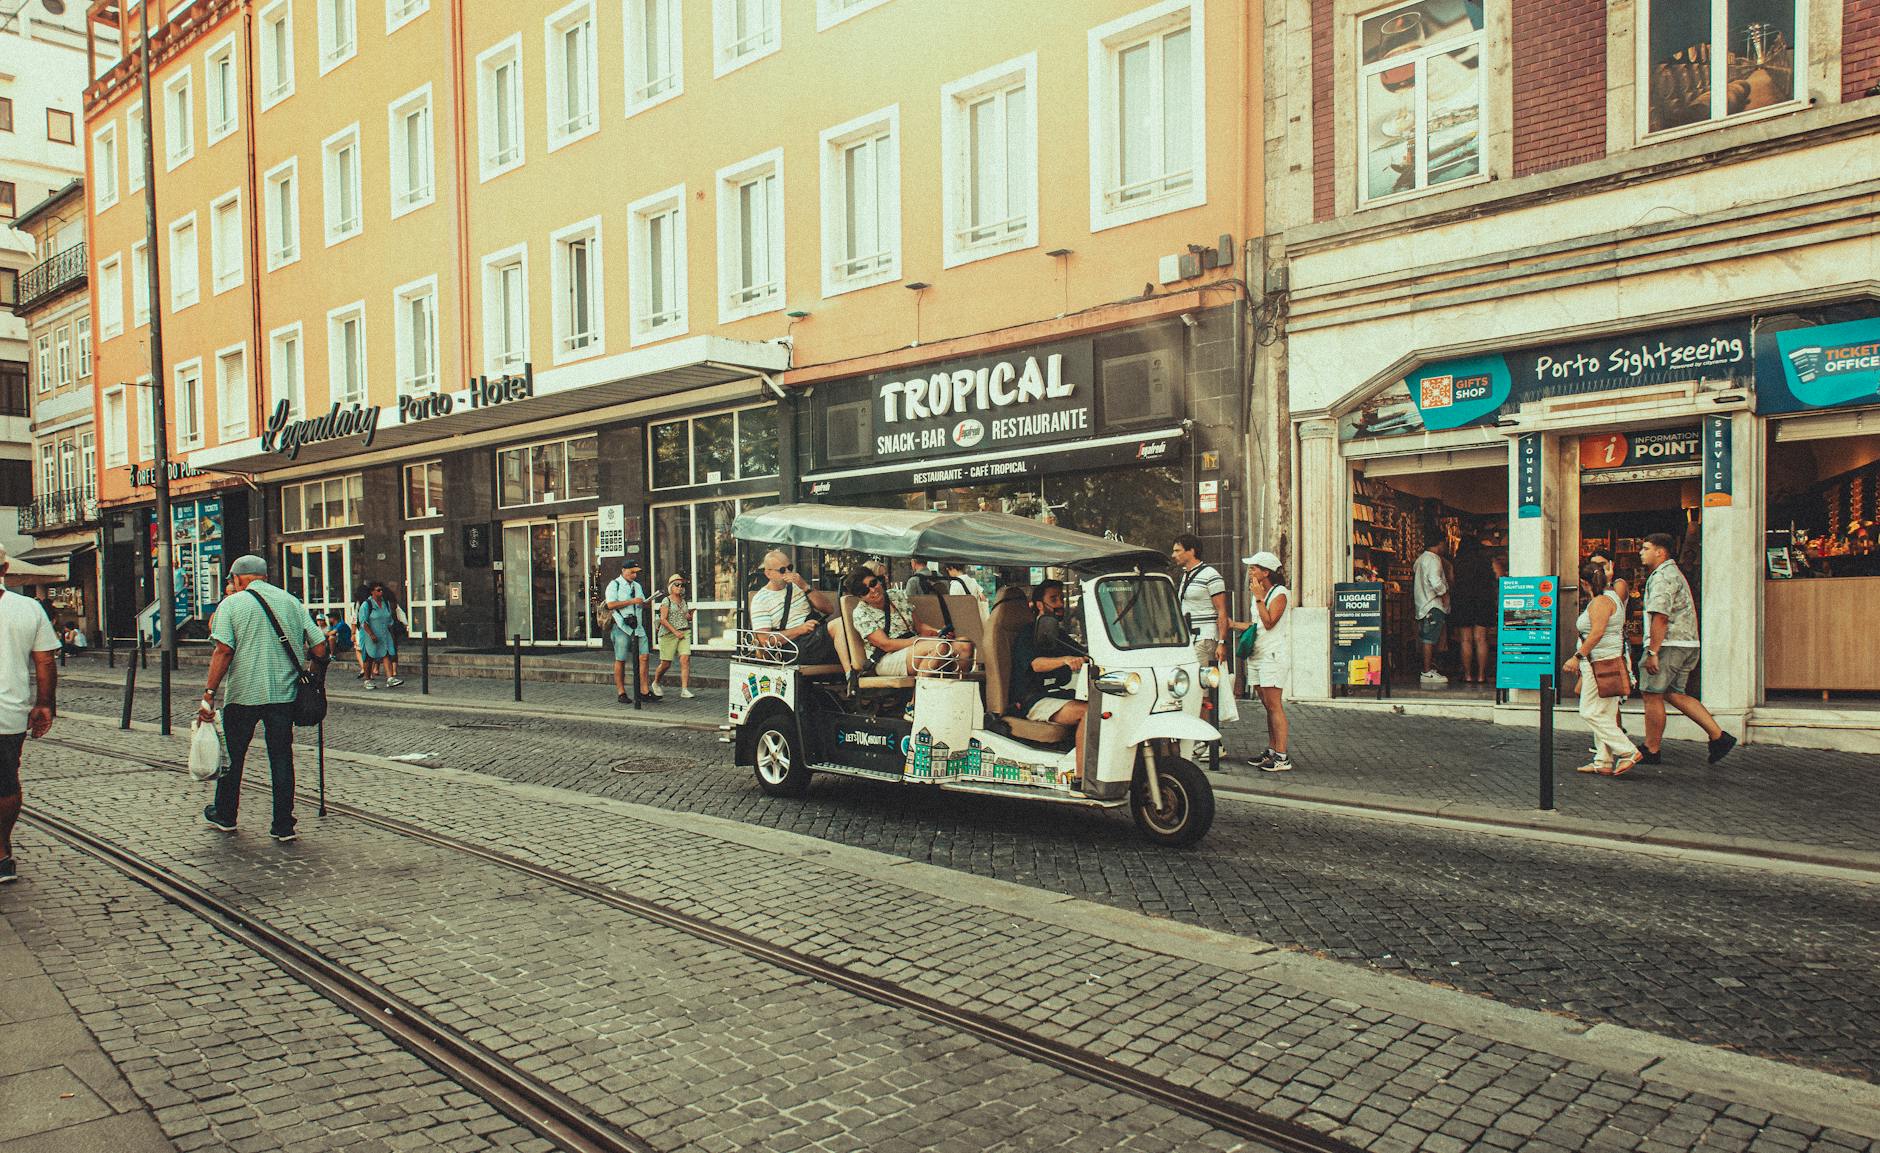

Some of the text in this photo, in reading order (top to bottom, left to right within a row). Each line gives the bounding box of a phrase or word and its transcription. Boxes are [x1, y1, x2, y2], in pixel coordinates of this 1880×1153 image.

[1535, 337, 1744, 380] Porto Sightseeing
[1825, 355, 1880, 372] OFFICE
[880, 353, 1075, 423] TROPICAL
[1455, 377, 1489, 389] GIFTS
[1455, 387, 1486, 399] SHOP
[261, 399, 381, 461] Legendary
[399, 391, 453, 424] Porto
[470, 362, 534, 409] Hotel
[992, 407, 1088, 440] RESTAURANTE
[877, 428, 946, 455] SNACK-BAR
[1635, 432, 1699, 444] INFORMATION
[1635, 440, 1699, 458] POINT
[1714, 420, 1722, 490] SERVICE
[913, 468, 963, 484] RESTAURANTE
[970, 463, 990, 478] CAFÉ
[990, 461, 1027, 476] TROPICAL
[1525, 438, 1534, 503] TOURISM
[1339, 593, 1377, 602] LUGGAGE
